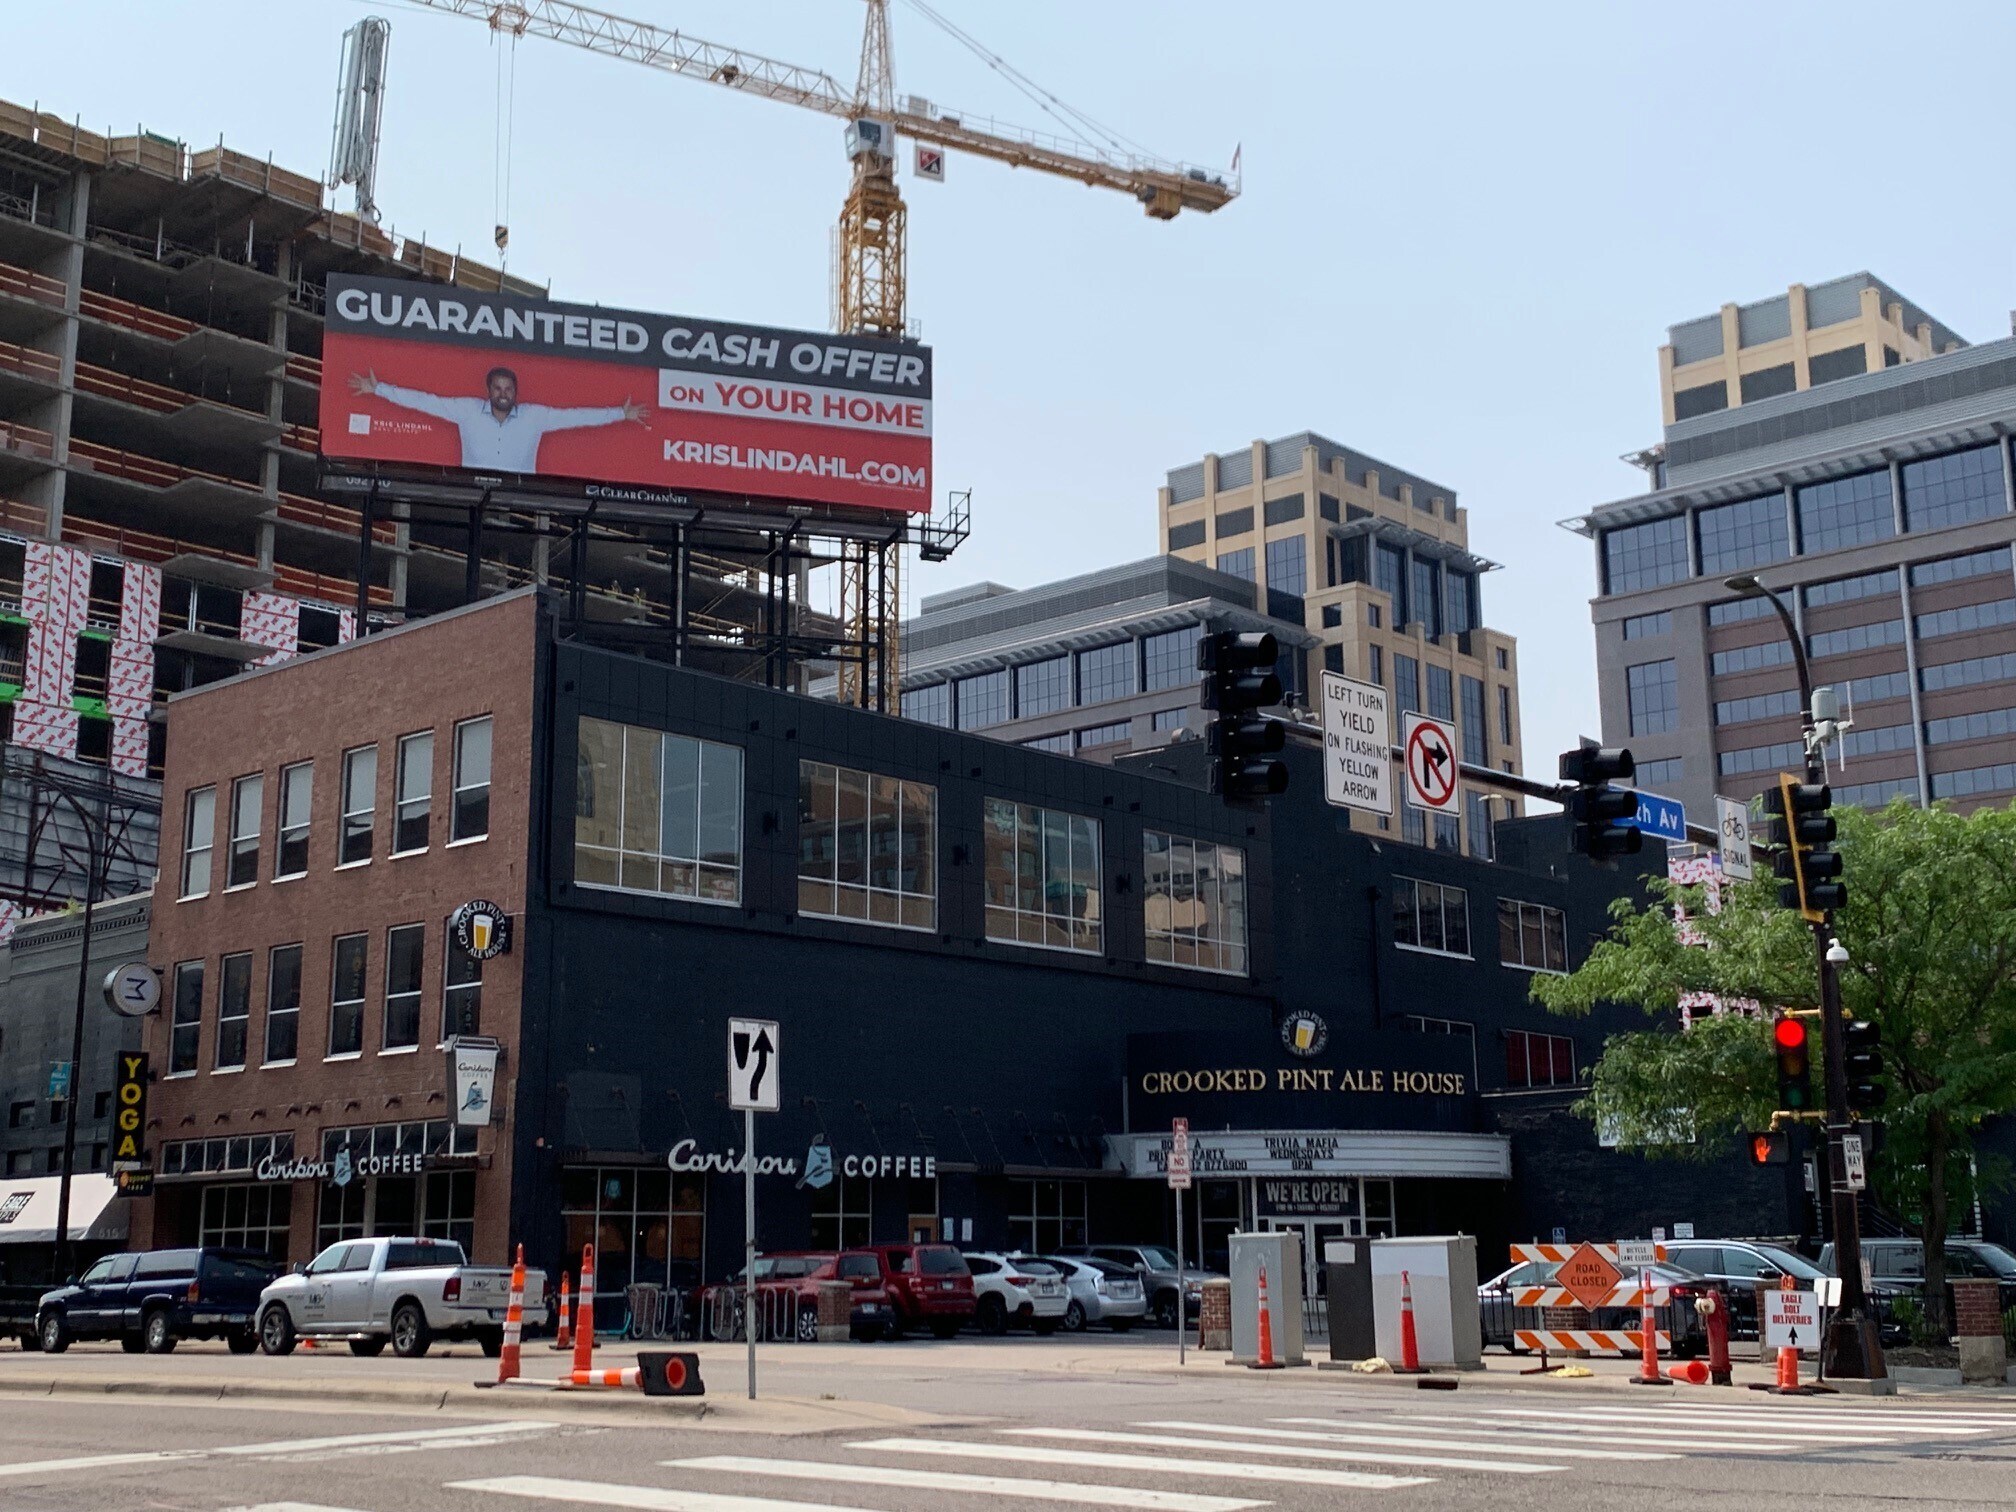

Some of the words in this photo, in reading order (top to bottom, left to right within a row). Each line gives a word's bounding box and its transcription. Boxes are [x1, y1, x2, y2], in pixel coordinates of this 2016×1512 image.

[335, 288, 650, 353] GUARANTEED
[661, 327, 780, 369] CASH
[789, 342, 925, 386] OFFER
[669, 385, 704, 404] ON
[714, 381, 813, 416] YOUR
[823, 394, 924, 429] HOME
[663, 439, 926, 488] KRISLINDAHL.COM
[1328, 683, 1352, 703] LEFT
[1357, 691, 1383, 712] TURN
[1339, 709, 1375, 735] YIELD
[1327, 732, 1340, 749] ON
[1345, 736, 1388, 761] FLASHING
[1339, 757, 1379, 780] YELLOW
[1342, 780, 1377, 801] ARROW
[1660, 807, 1677, 830] Av
[1723, 848, 1749, 868] SIGNAL
[458, 901, 486, 945] CROOKED
[467, 947, 483, 959] ALE
[1142, 1069, 1267, 1094] CROOKED
[1277, 1069, 1334, 1091] PINT
[1339, 1069, 1384, 1092] ALE
[1392, 1071, 1465, 1096] HOUSE
[118, 1057, 142, 1156] YOGA
[1264, 1137, 1299, 1148] TRIVIA
[1306, 1138, 1339, 1148] MAFIA
[1846, 1140, 1860, 1153] ONE
[1174, 1157, 1185, 1166] NO
[1192, 1149, 1225, 1161] PARTY
[1269, 1148, 1334, 1159] WEDNESDAYS
[1847, 1155, 1862, 1167] WAY
[257, 1155, 329, 1179] Caribou
[357, 1153, 422, 1175] COFFEE
[844, 1155, 936, 1178] COFFEE
[1266, 1181, 1309, 1203] WE'RE
[1312, 1181, 1349, 1203] OPEN
[1621, 1254, 1633, 1262] LANE
[1626, 1246, 1646, 1254] BICYCLE
[1575, 1263, 1600, 1274] ROAD
[1570, 1276, 1607, 1287] CLOSED
[1781, 1294, 1802, 1304] EAGLE
[1784, 1305, 1800, 1314] BOLT
[1773, 1315, 1812, 1325] DELIVERIES
